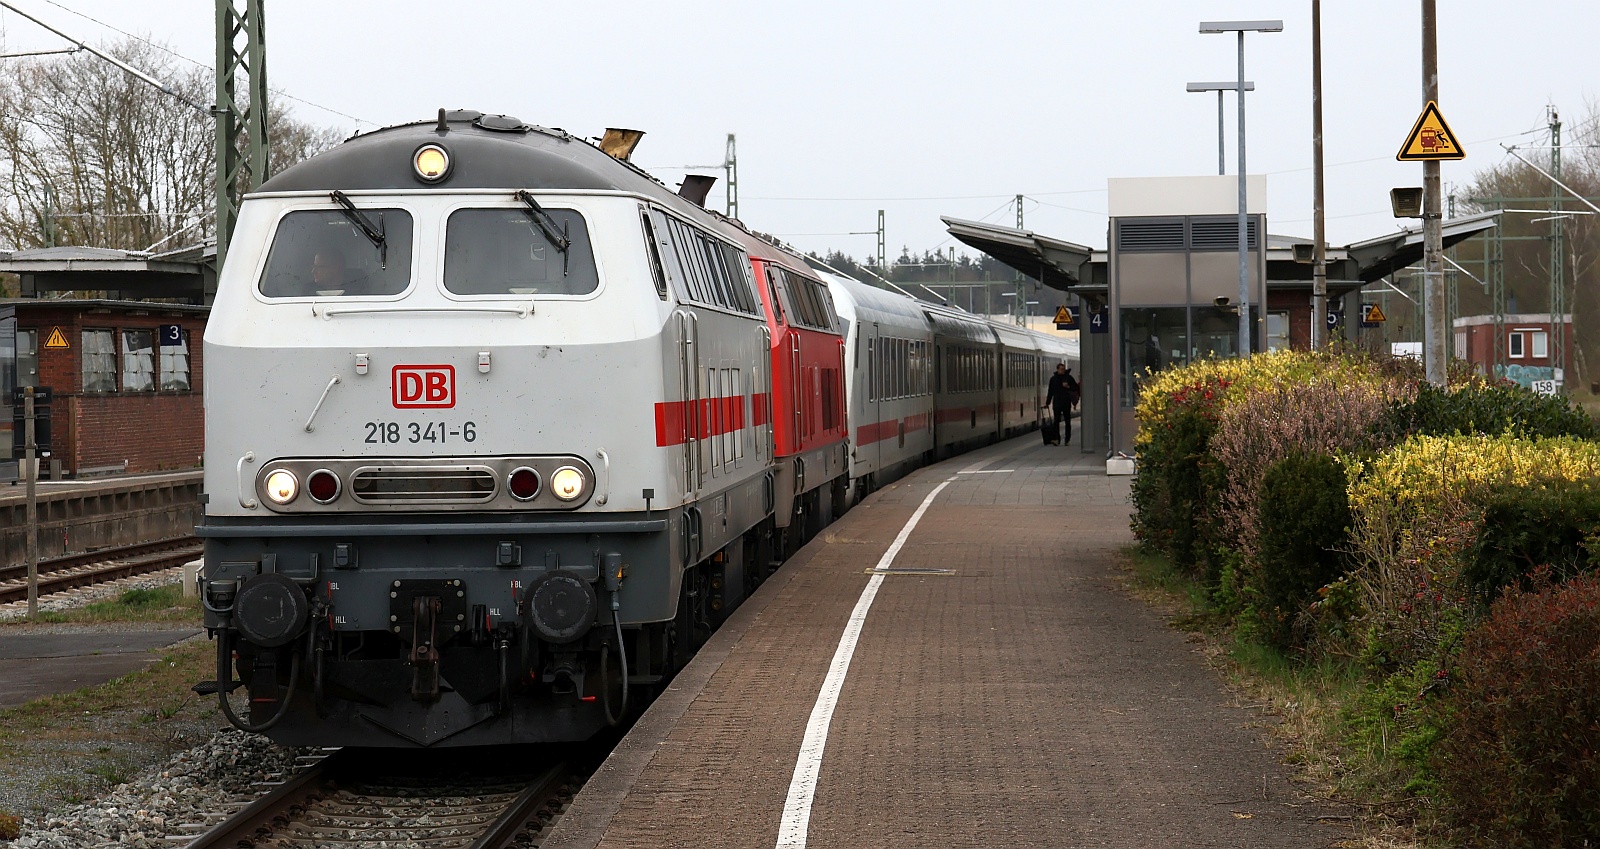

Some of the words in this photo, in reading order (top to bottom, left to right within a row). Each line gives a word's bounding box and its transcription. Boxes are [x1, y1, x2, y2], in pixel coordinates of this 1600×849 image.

[1092, 313, 1102, 327] 4
[1327, 311, 1337, 324] 5
[169, 325, 179, 340] 3
[399, 371, 449, 402] DB
[1535, 381, 1553, 393] 158
[364, 422, 401, 443] 218
[407, 421, 477, 443] 341-6
[489, 608, 501, 616] HLL
[335, 616, 347, 624] HLL
